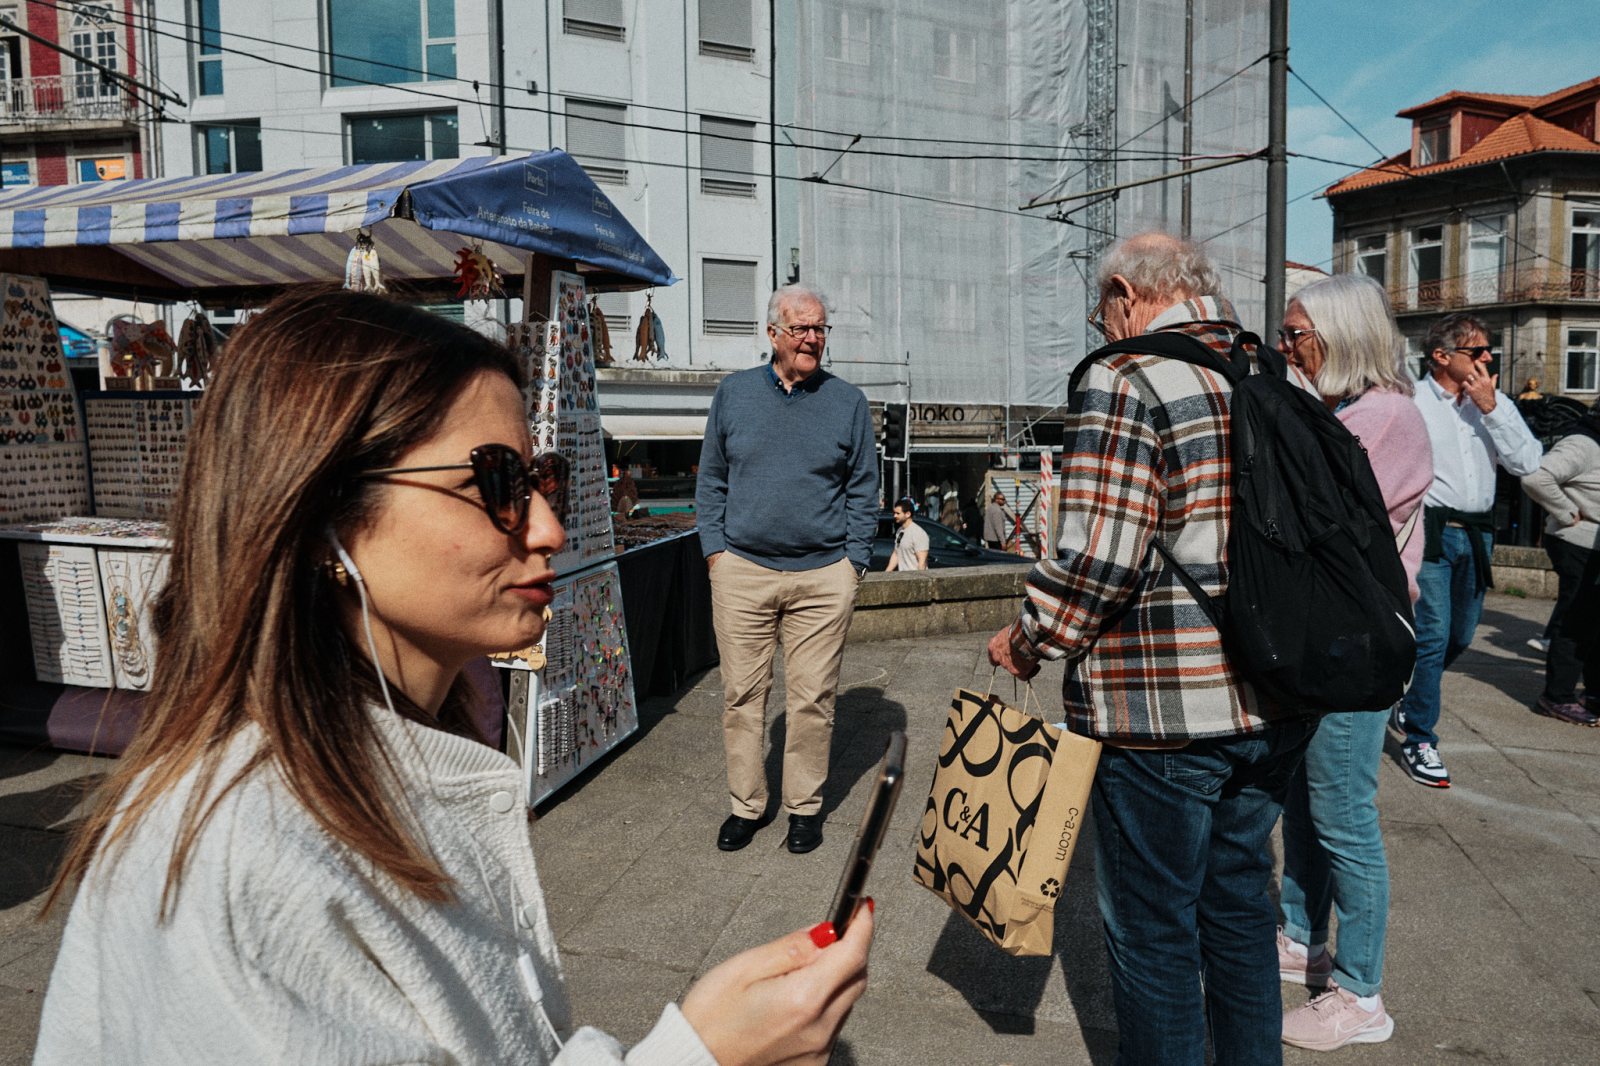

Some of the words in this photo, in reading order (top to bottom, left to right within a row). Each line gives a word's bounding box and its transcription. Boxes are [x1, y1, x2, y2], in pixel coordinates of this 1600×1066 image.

[522, 201, 540, 217] Feira
[943, 788, 990, 852] C&A
[1055, 807, 1079, 861] c-a.com
